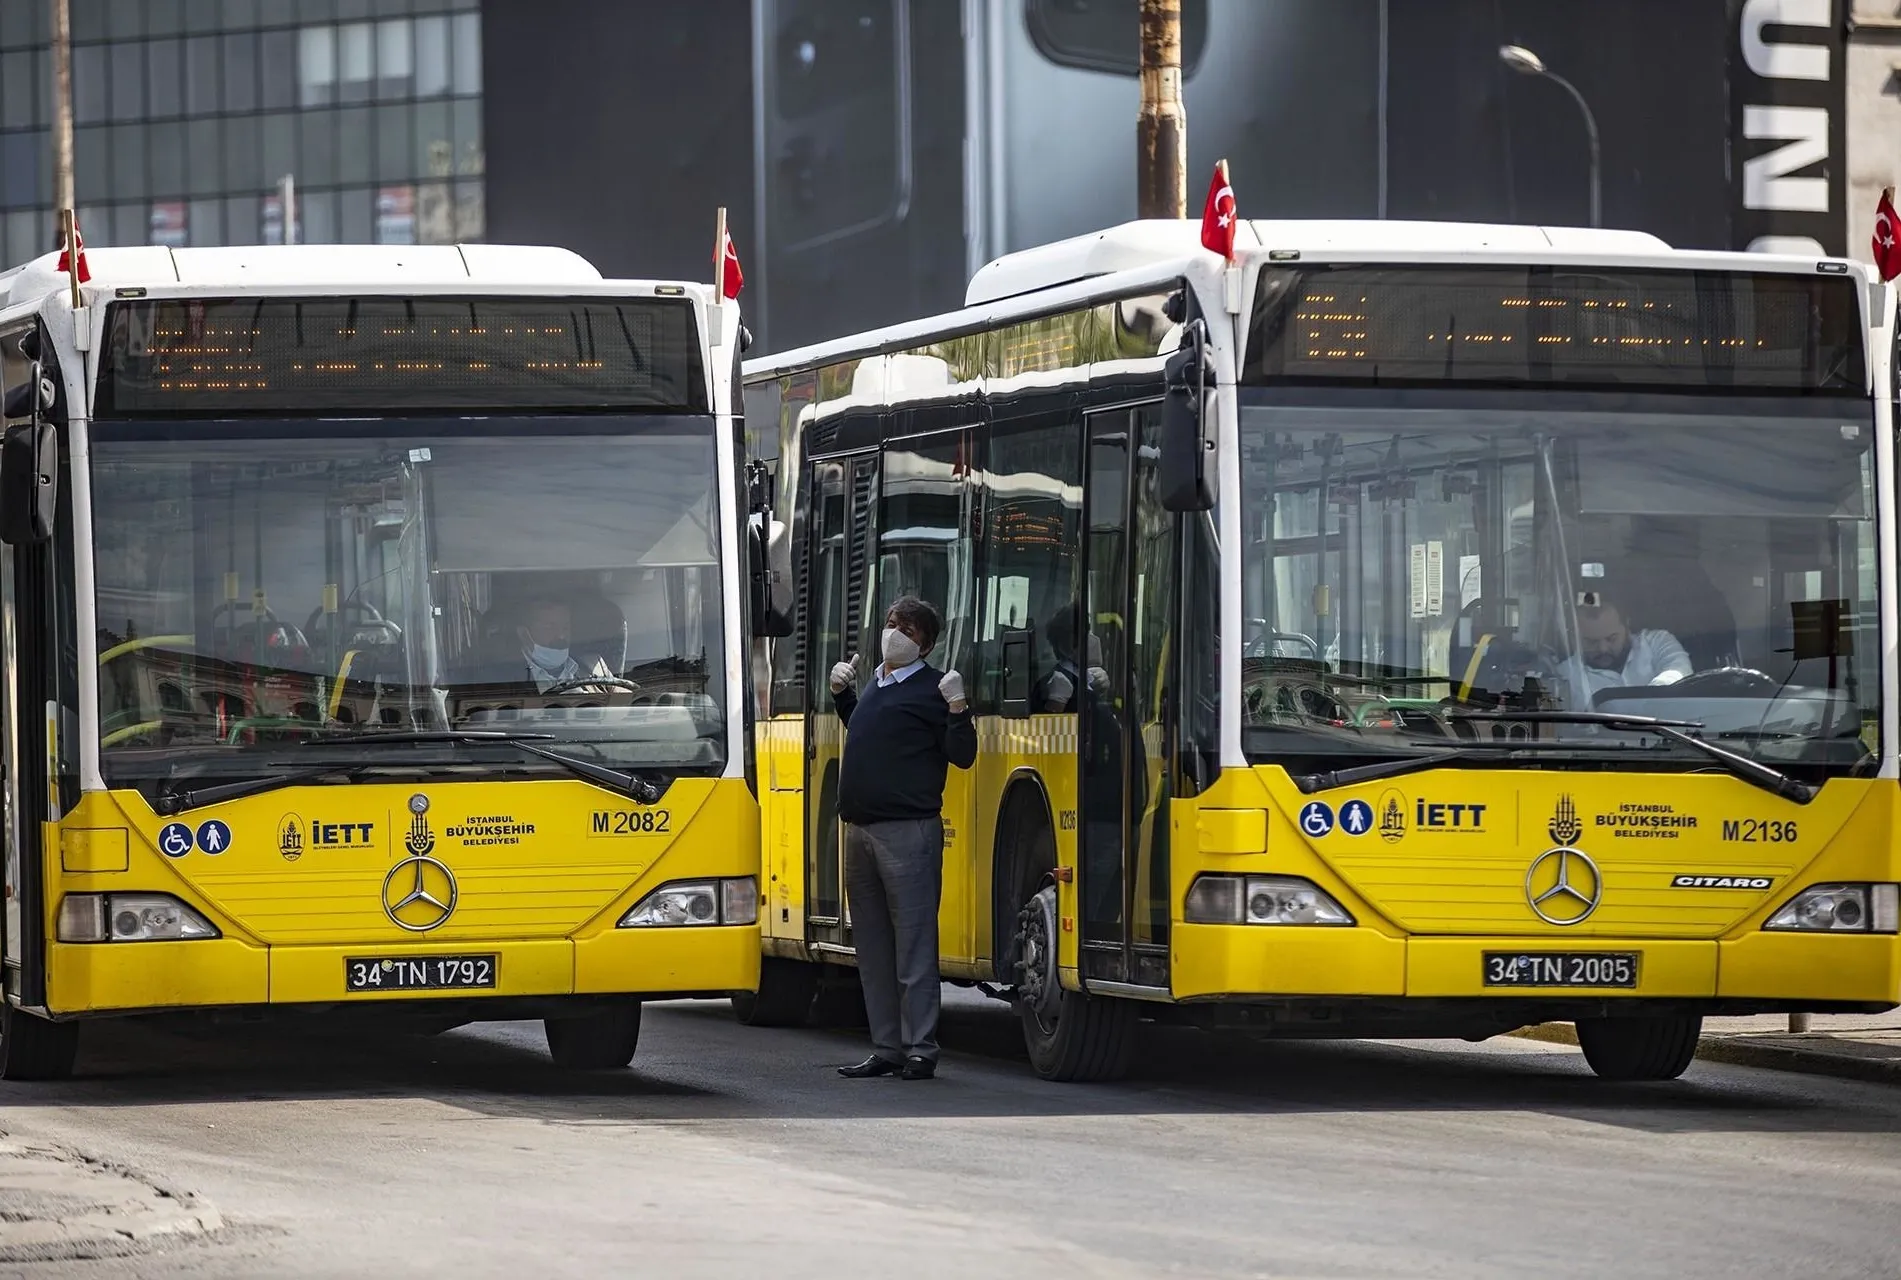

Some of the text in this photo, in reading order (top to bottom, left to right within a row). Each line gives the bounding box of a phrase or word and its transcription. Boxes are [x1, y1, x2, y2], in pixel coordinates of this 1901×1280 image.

[1416, 798, 1486, 827] İETT
[1619, 802, 1674, 813] İSTANBUL
[466, 815, 514, 825] İSTANBUL
[1595, 812, 1698, 829] BÜYÜKŞEHİR
[312, 820, 374, 844] İETT
[446, 823, 536, 839] BÜYÜKŞEHİR
[463, 836, 519, 846] BELEDİYESİ
[1675, 876, 1771, 888] CITARO
[353, 960, 490, 987] 34 TN 1792
[1489, 957, 1630, 983] 34 TN 2005
